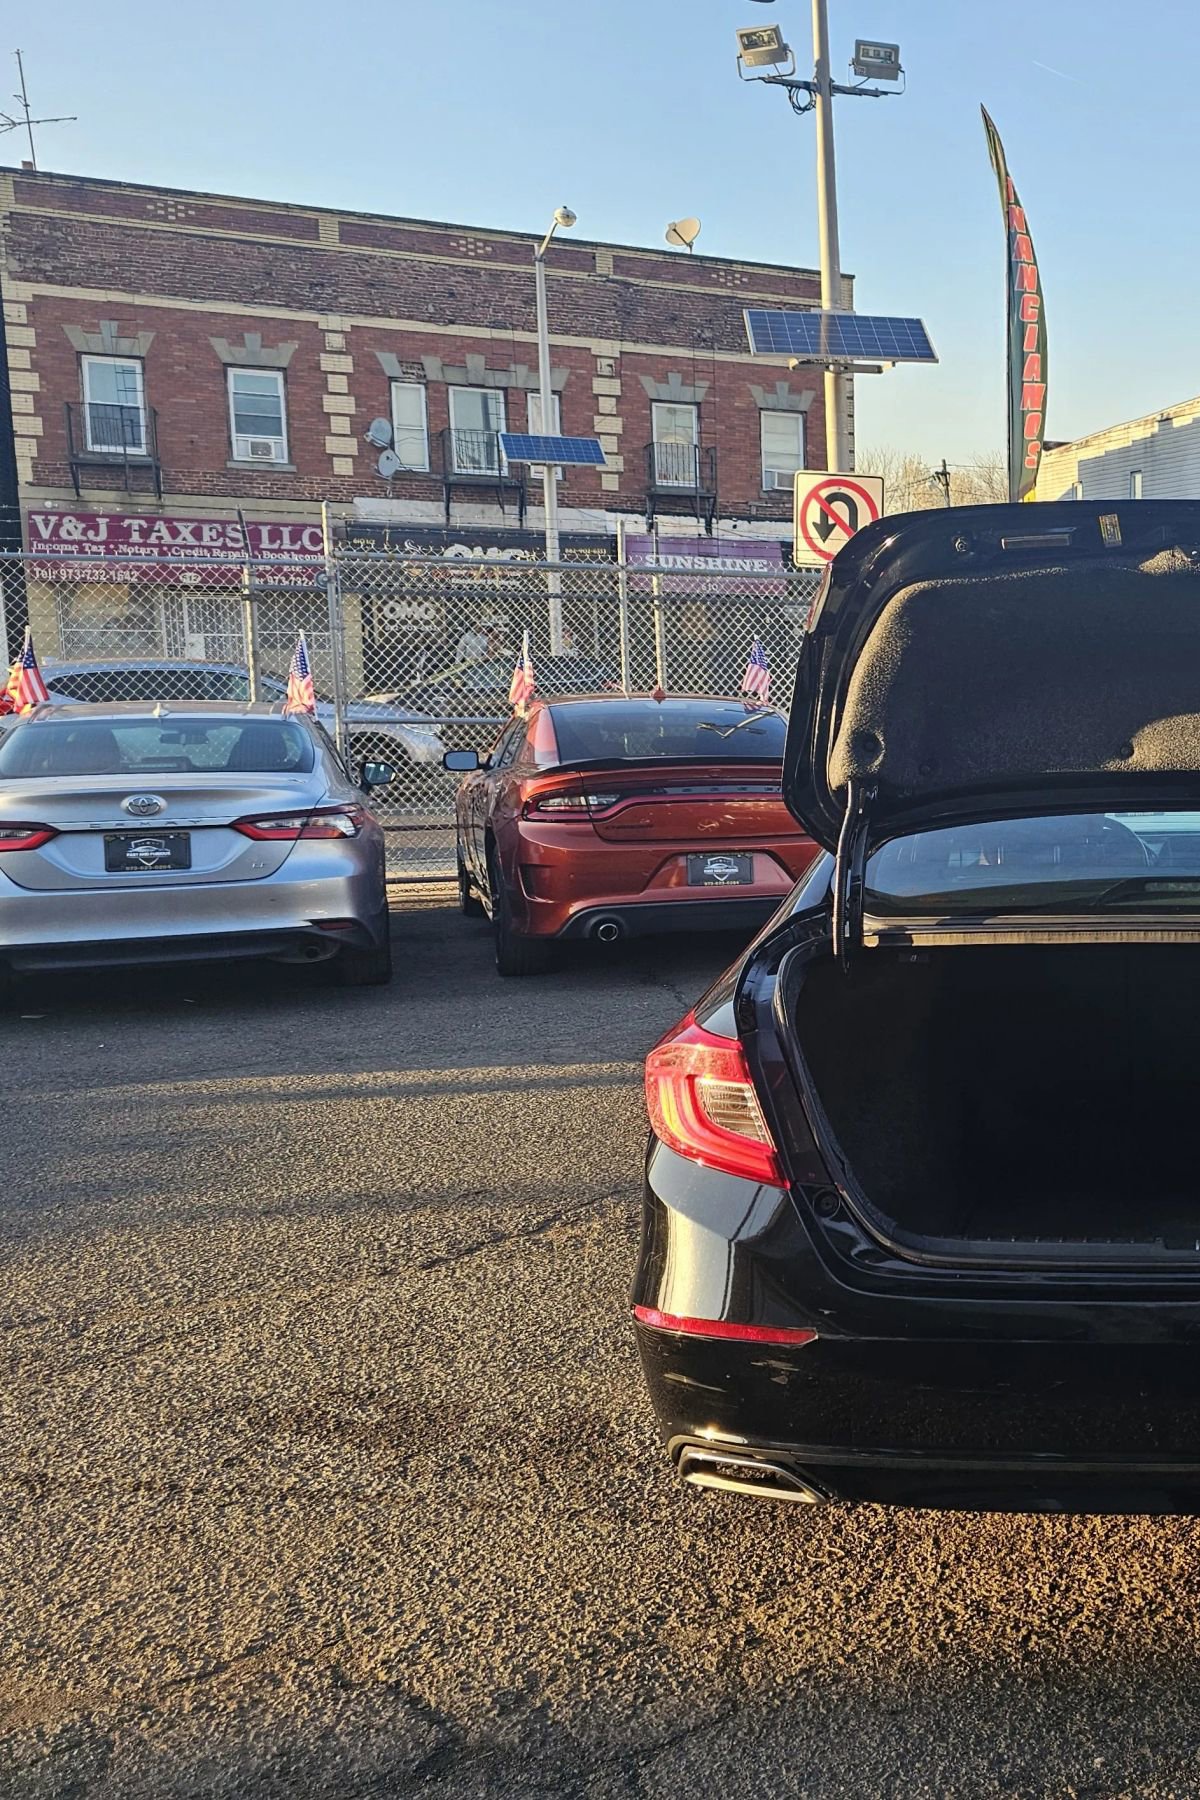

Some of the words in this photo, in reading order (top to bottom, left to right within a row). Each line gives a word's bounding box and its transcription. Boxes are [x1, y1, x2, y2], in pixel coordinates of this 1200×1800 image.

[31, 515, 110, 541] V&J
[123, 518, 245, 548] TAXES
[260, 525, 324, 552] LLC
[32, 541, 79, 551] Income
[82, 543, 106, 552] Tax
[644, 554, 768, 572] SUNSHINE
